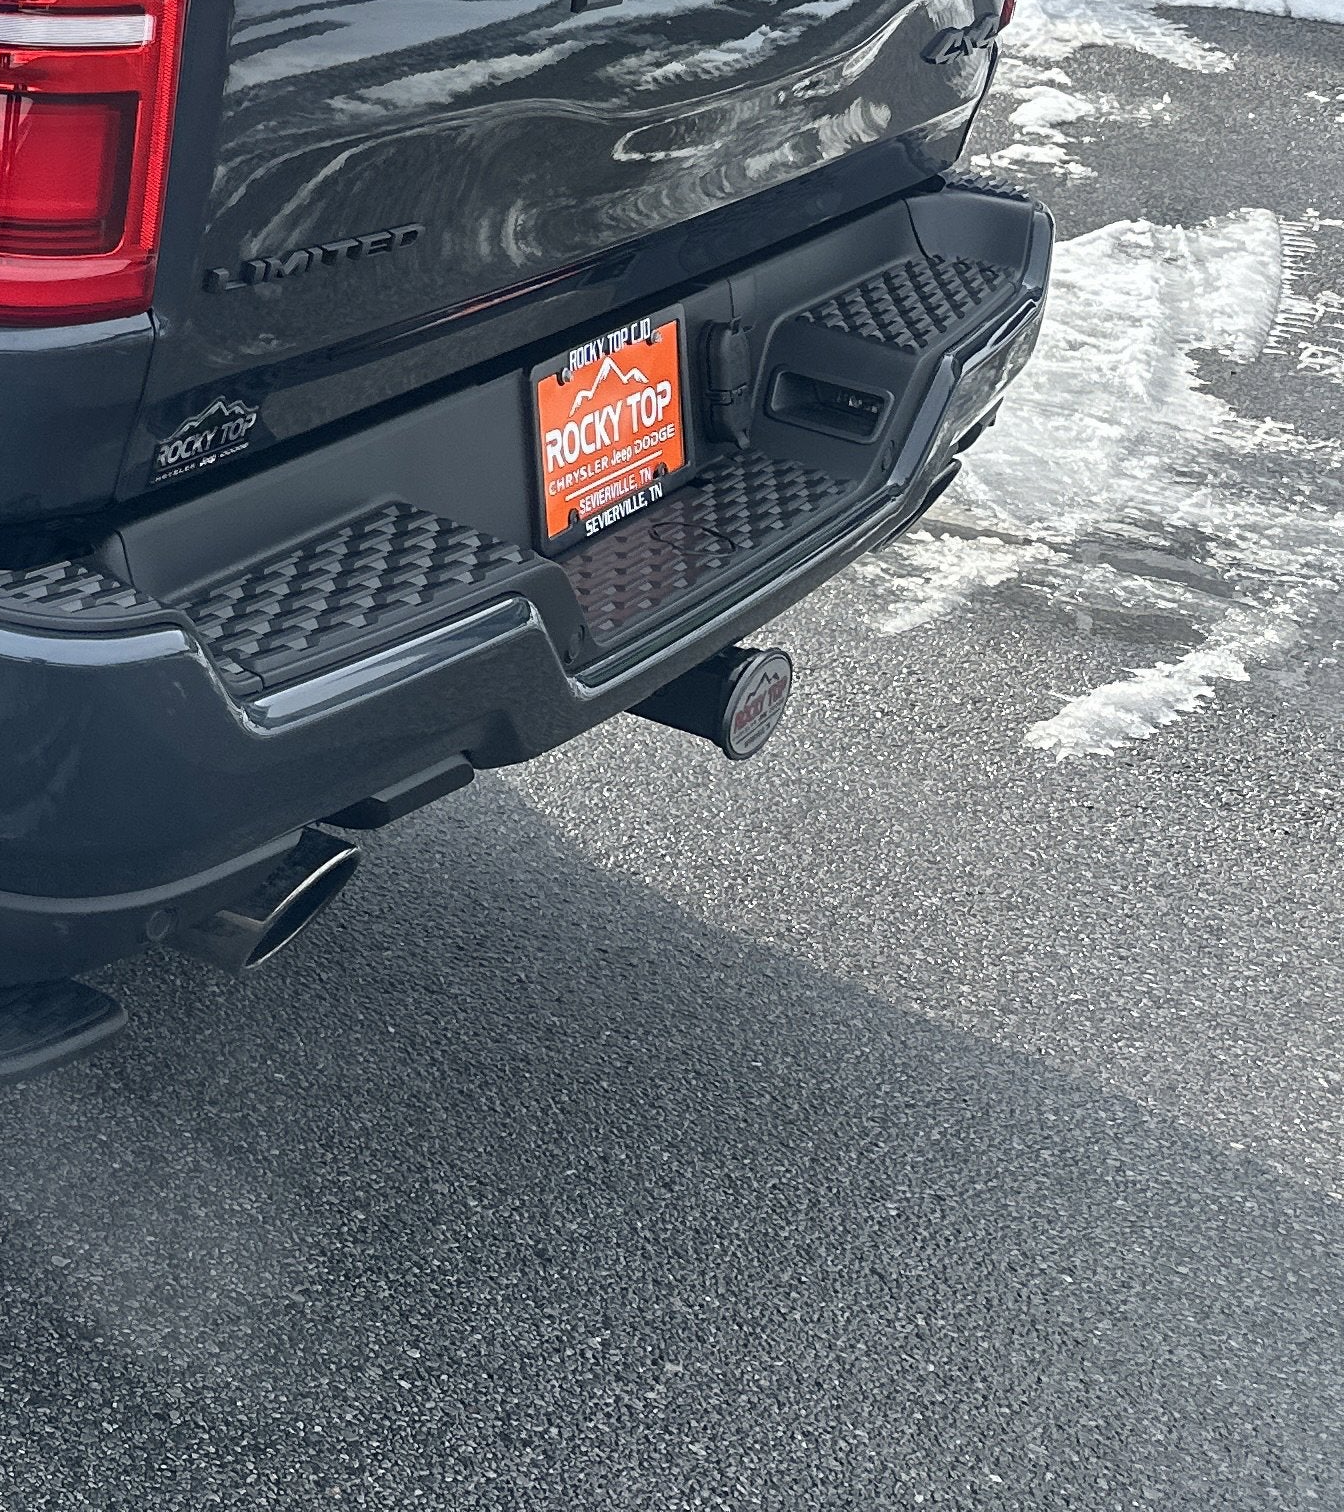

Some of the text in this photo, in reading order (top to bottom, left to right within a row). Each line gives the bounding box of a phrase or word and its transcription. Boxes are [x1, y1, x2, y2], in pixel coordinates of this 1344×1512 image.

[204, 223, 426, 291] LIMITED
[569, 317, 651, 372] ROCKY TOP CJD
[157, 426, 219, 467] ROCKY
[221, 412, 257, 445] TOP
[545, 380, 672, 473] ROCKY TOP
[548, 423, 675, 496] CHRYSLER Jeep DODGE
[639, 467, 652, 485] TN
[648, 482, 663, 502] TN
